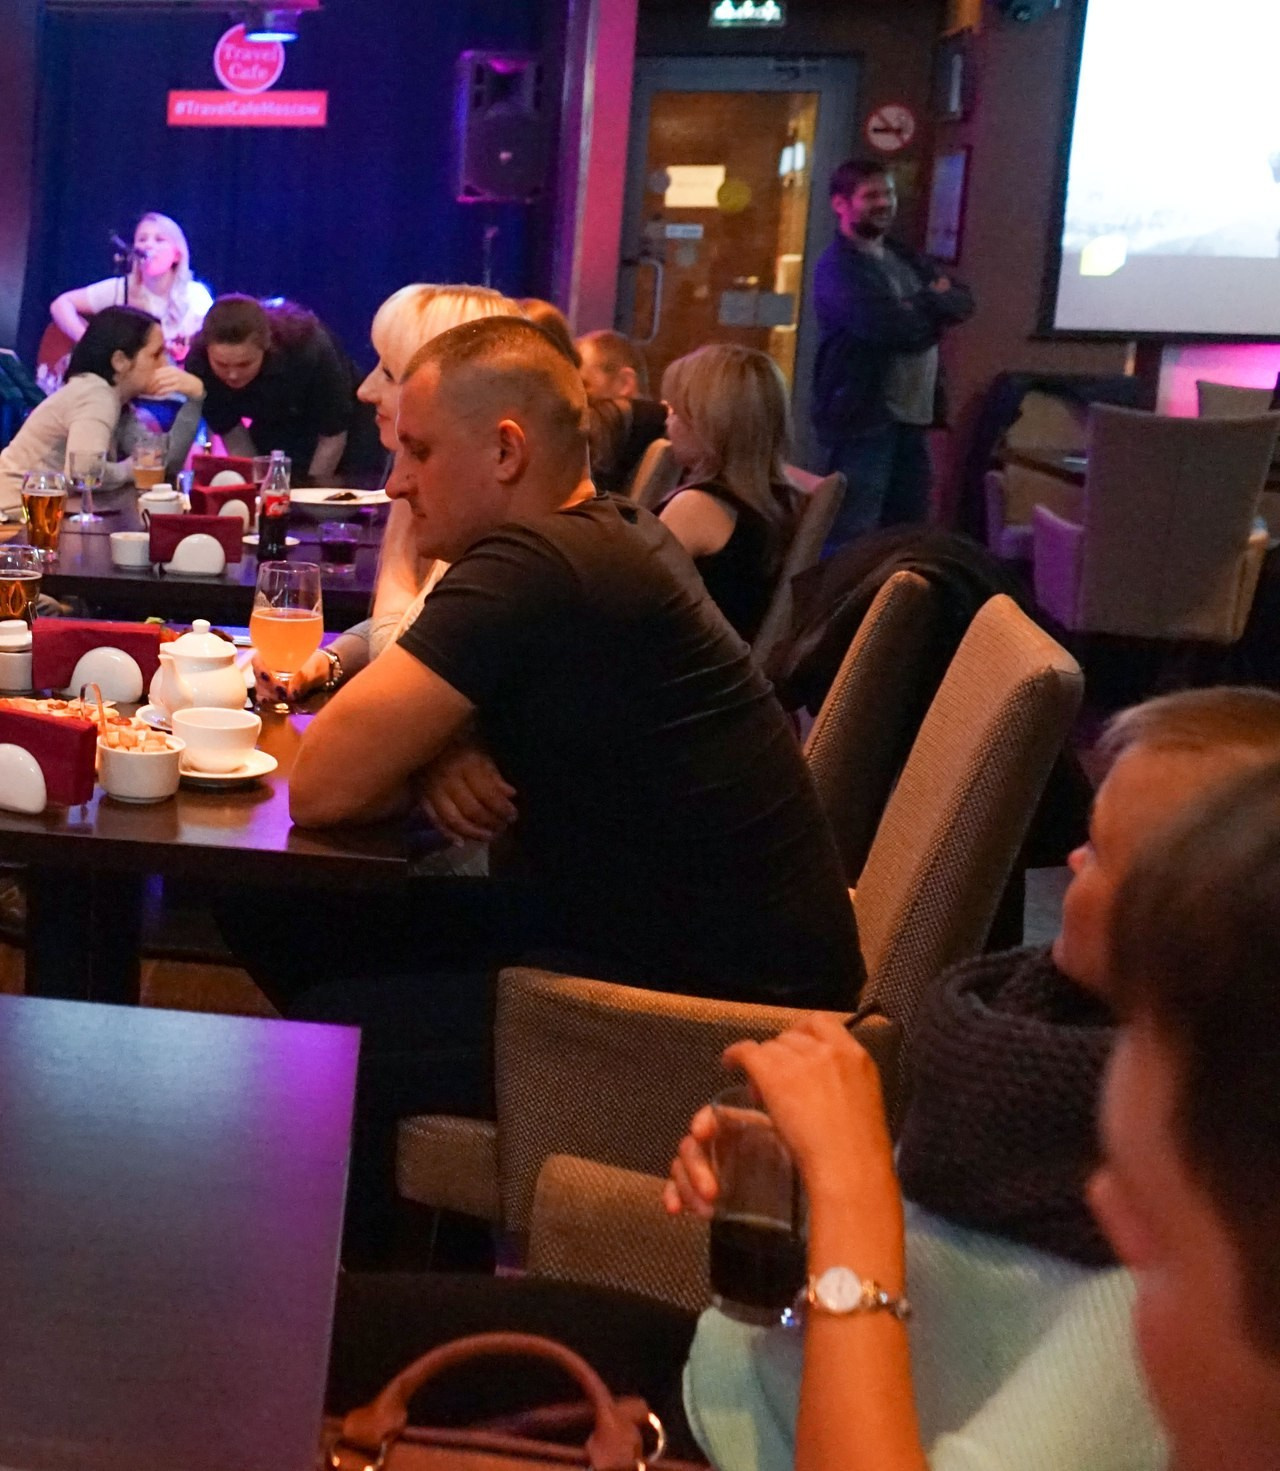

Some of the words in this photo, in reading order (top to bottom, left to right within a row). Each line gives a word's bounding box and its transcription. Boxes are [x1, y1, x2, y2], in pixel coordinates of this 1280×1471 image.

[224, 43, 277, 61] Travel
[227, 63, 269, 80] Cafe
[175, 100, 319, 116] #TravelCafeMoscow
